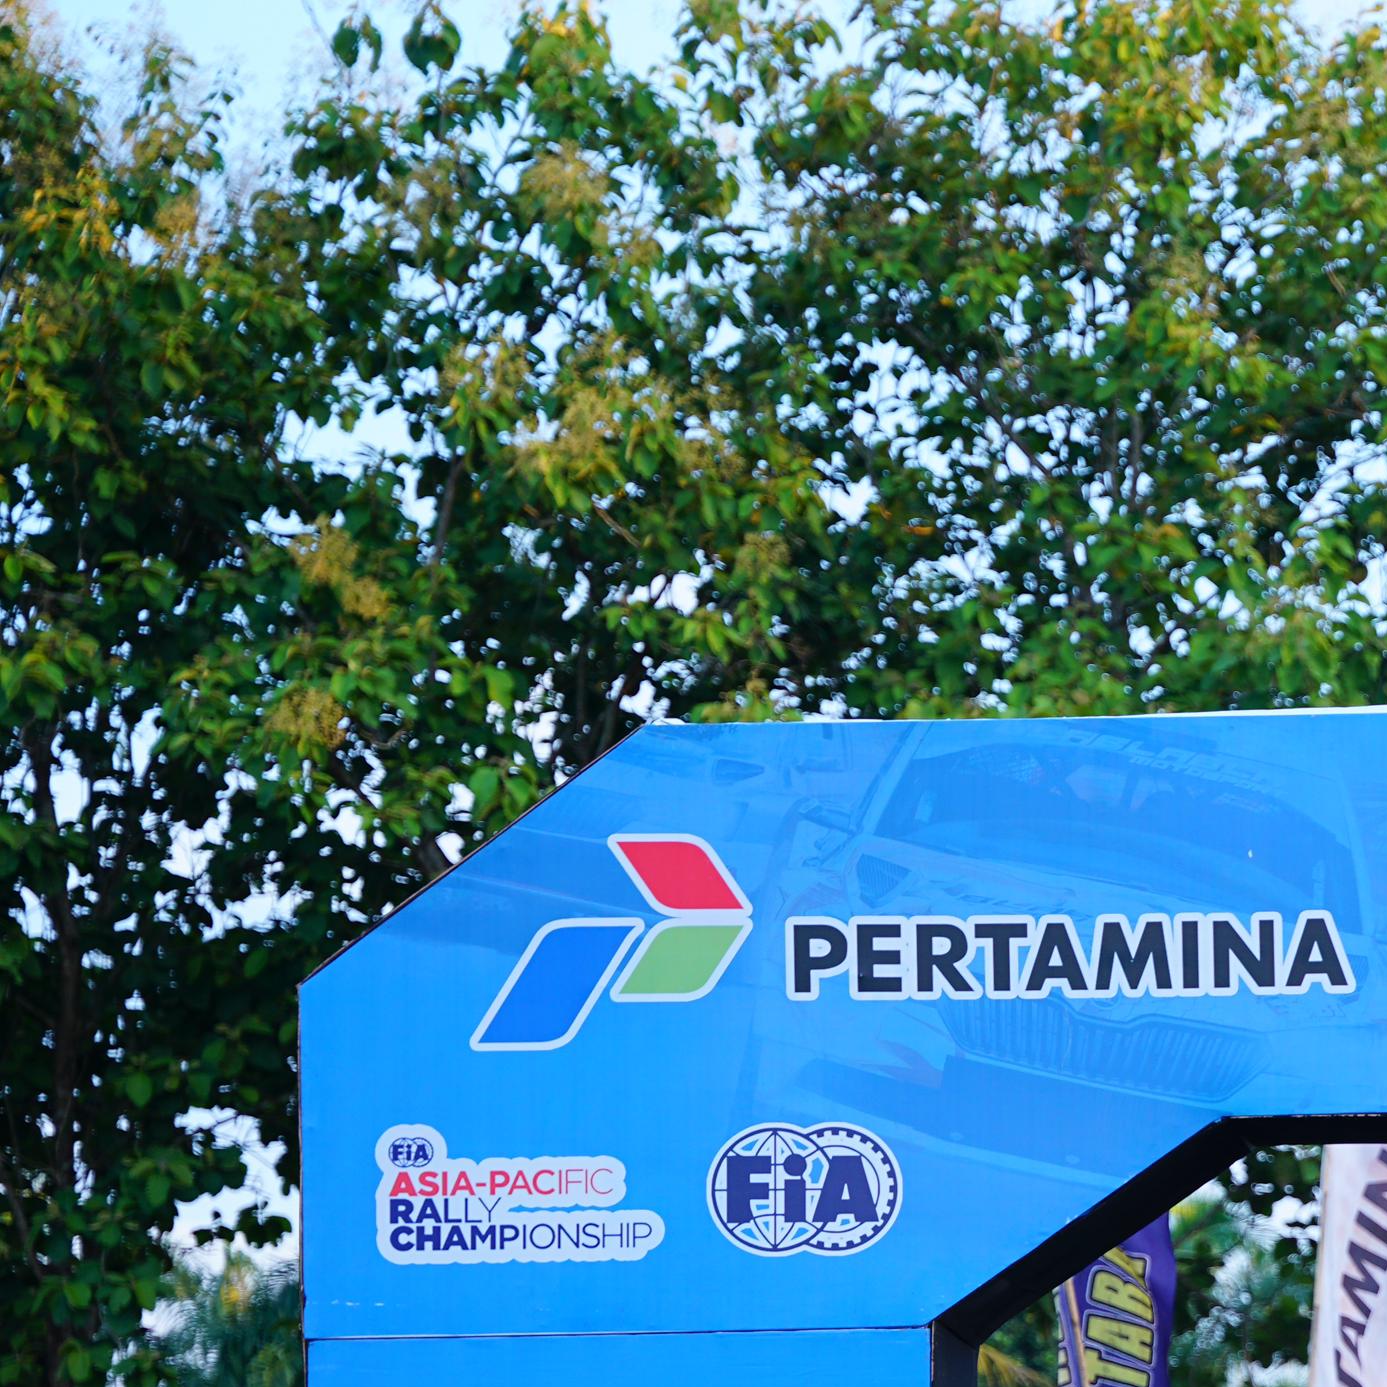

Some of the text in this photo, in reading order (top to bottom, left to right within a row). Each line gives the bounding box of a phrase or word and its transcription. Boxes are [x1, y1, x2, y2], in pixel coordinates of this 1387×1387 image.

[794, 917, 1349, 994] PERTAMINA
[389, 1168, 614, 1198] ASIA-PACIFIC
[389, 1197, 503, 1225] RALLY
[389, 1222, 653, 1252] CHAMPIONSHIP
